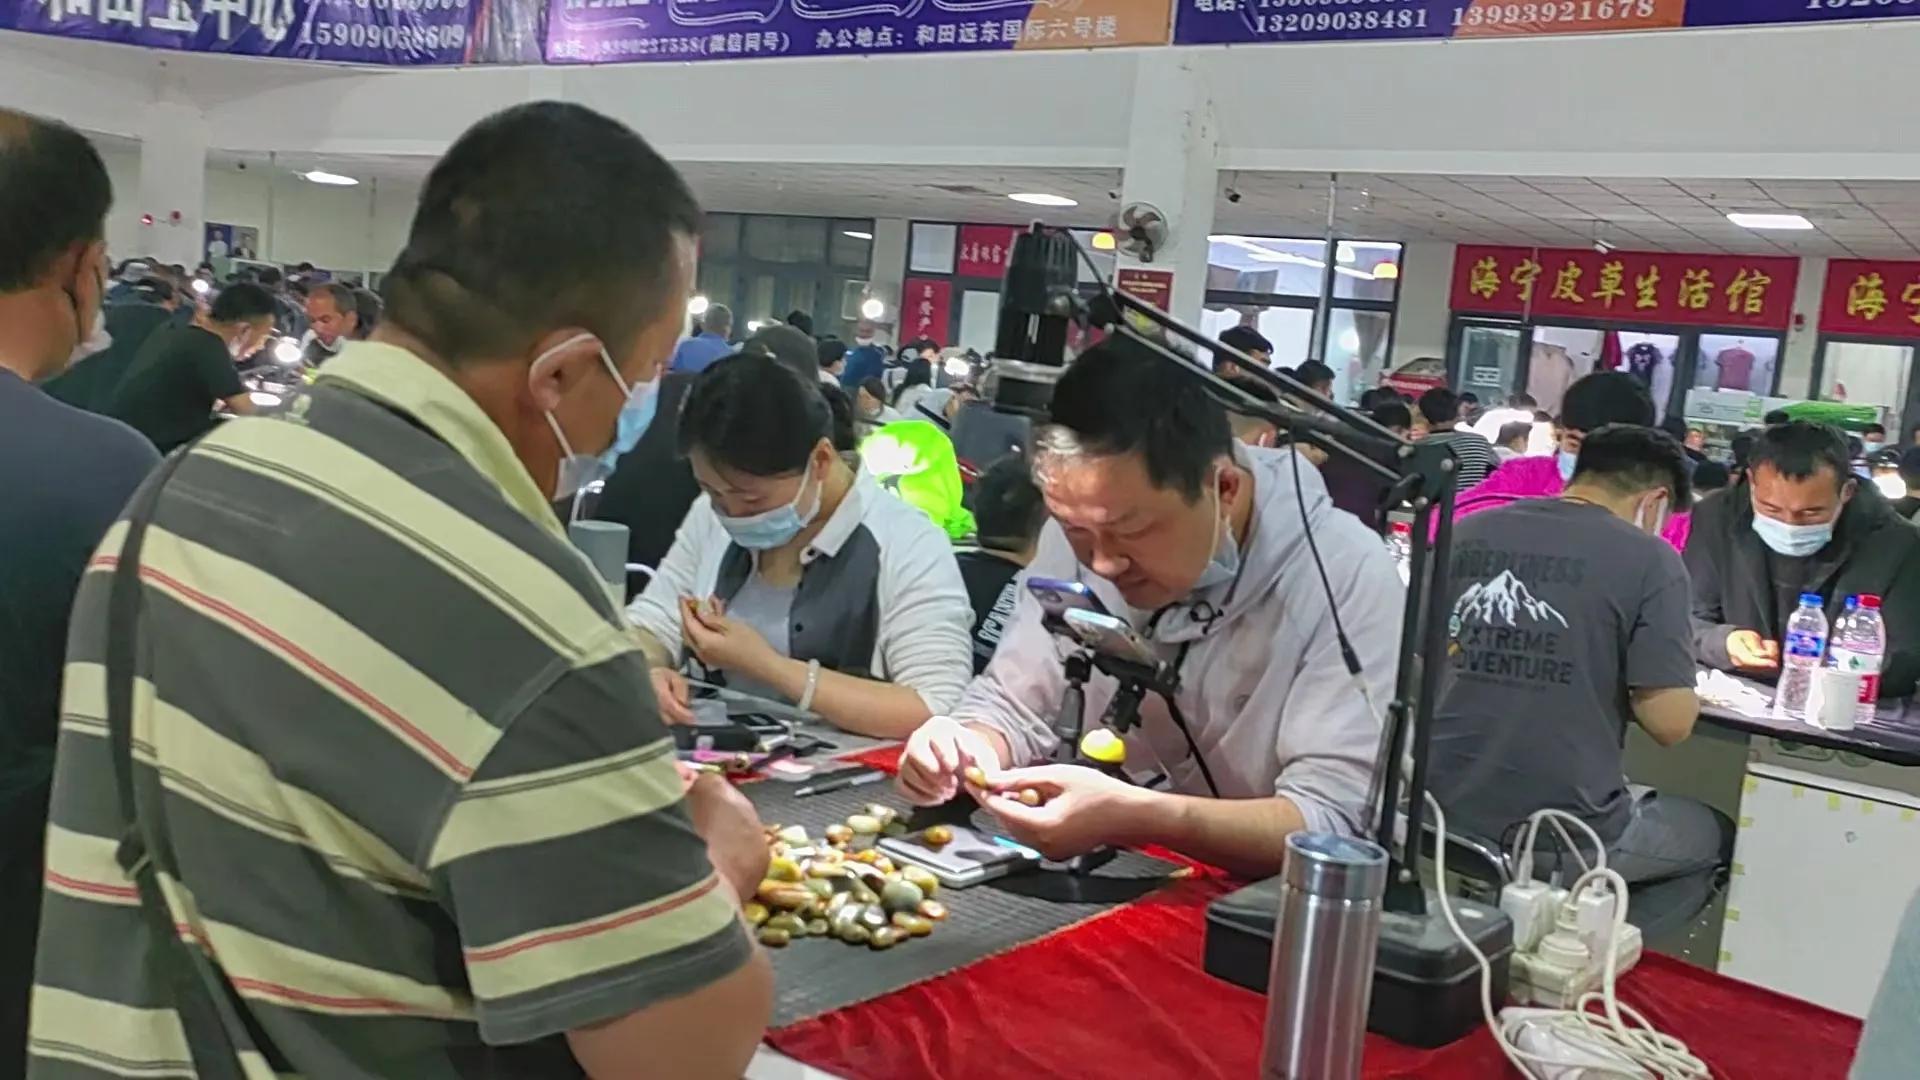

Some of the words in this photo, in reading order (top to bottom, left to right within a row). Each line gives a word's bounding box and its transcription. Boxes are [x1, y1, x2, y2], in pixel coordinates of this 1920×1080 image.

[1255, 8, 1428, 33] 13209038481
[1450, 0, 1655, 26] 13993921678
[1469, 256, 1772, 314] 海宁皮草生活馆
[1464, 622, 1560, 655] XTREME
[1451, 648, 1576, 685] DVENTURE
